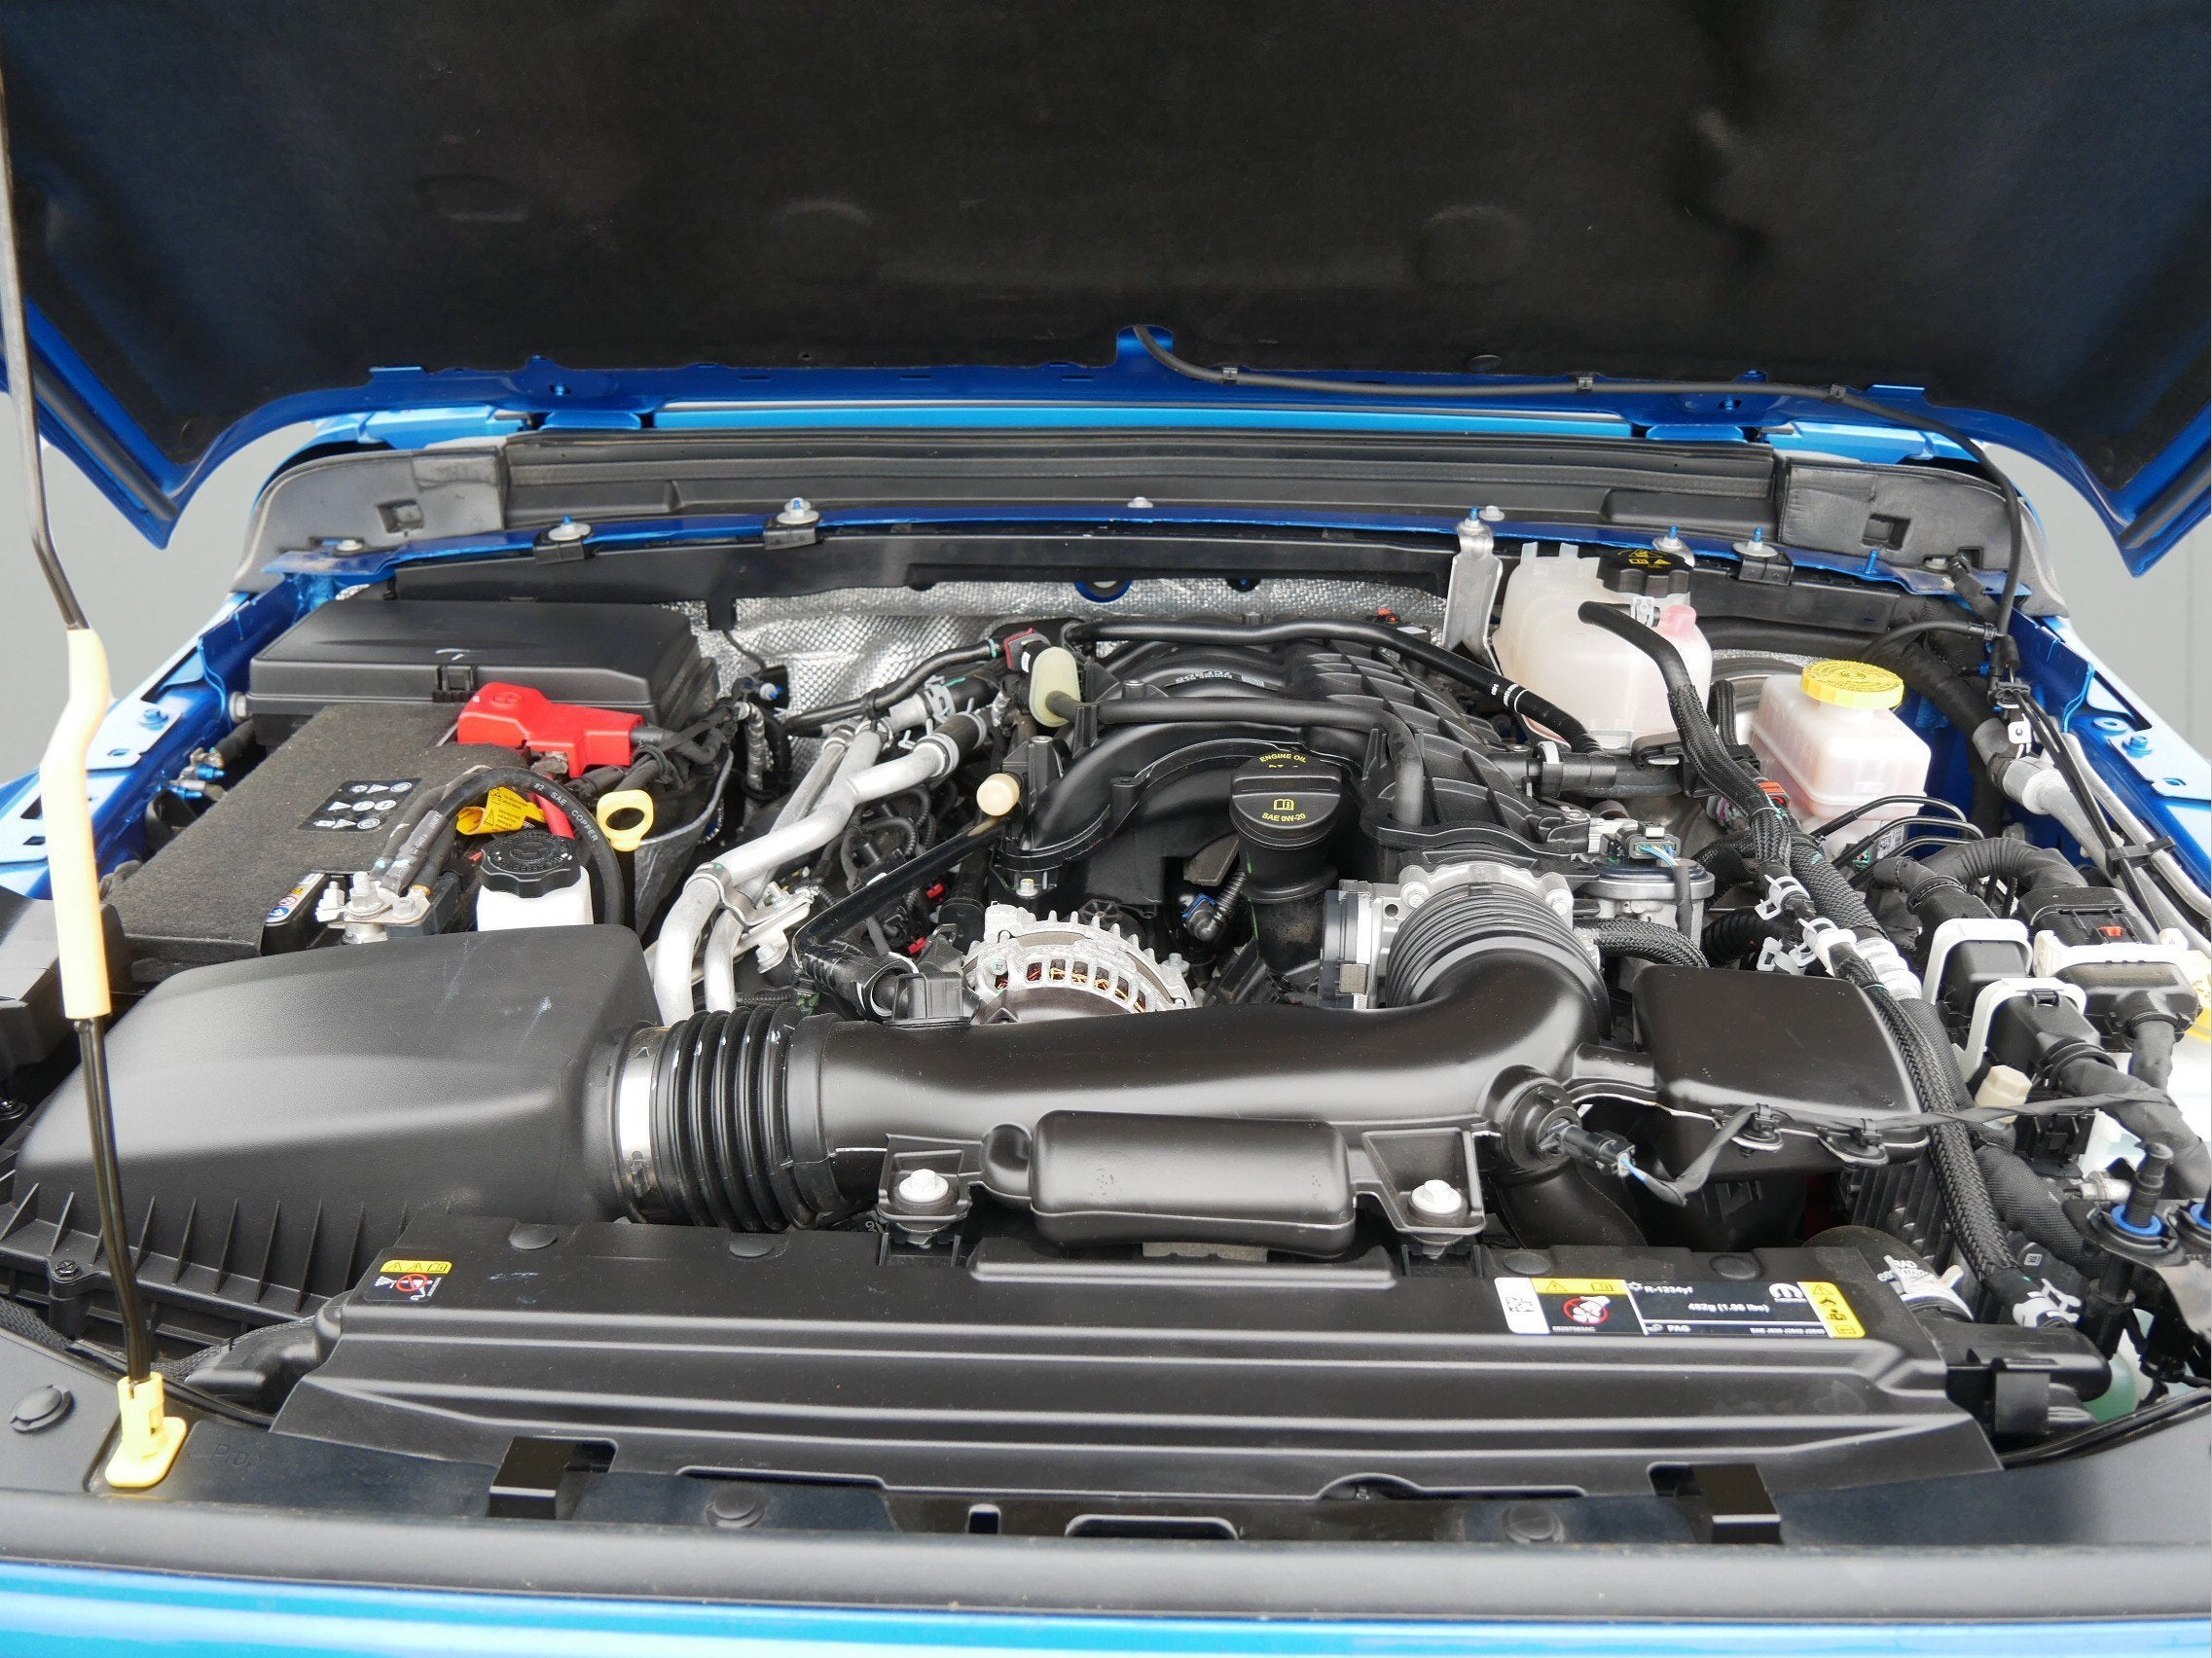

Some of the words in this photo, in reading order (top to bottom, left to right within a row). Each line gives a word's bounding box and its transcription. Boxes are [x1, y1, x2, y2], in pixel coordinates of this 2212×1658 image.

[1259, 753, 1292, 763] ENGINE
[1293, 754, 1307, 764] OIL
[551, 791, 567, 807] SAE
[571, 810, 598, 842] COPPER
[1261, 811, 1280, 822] SAE
[1281, 812, 1307, 822] 0W-20
[1644, 1285, 1693, 1295] R-1234yf
[1667, 1324, 1691, 1333] PAG
